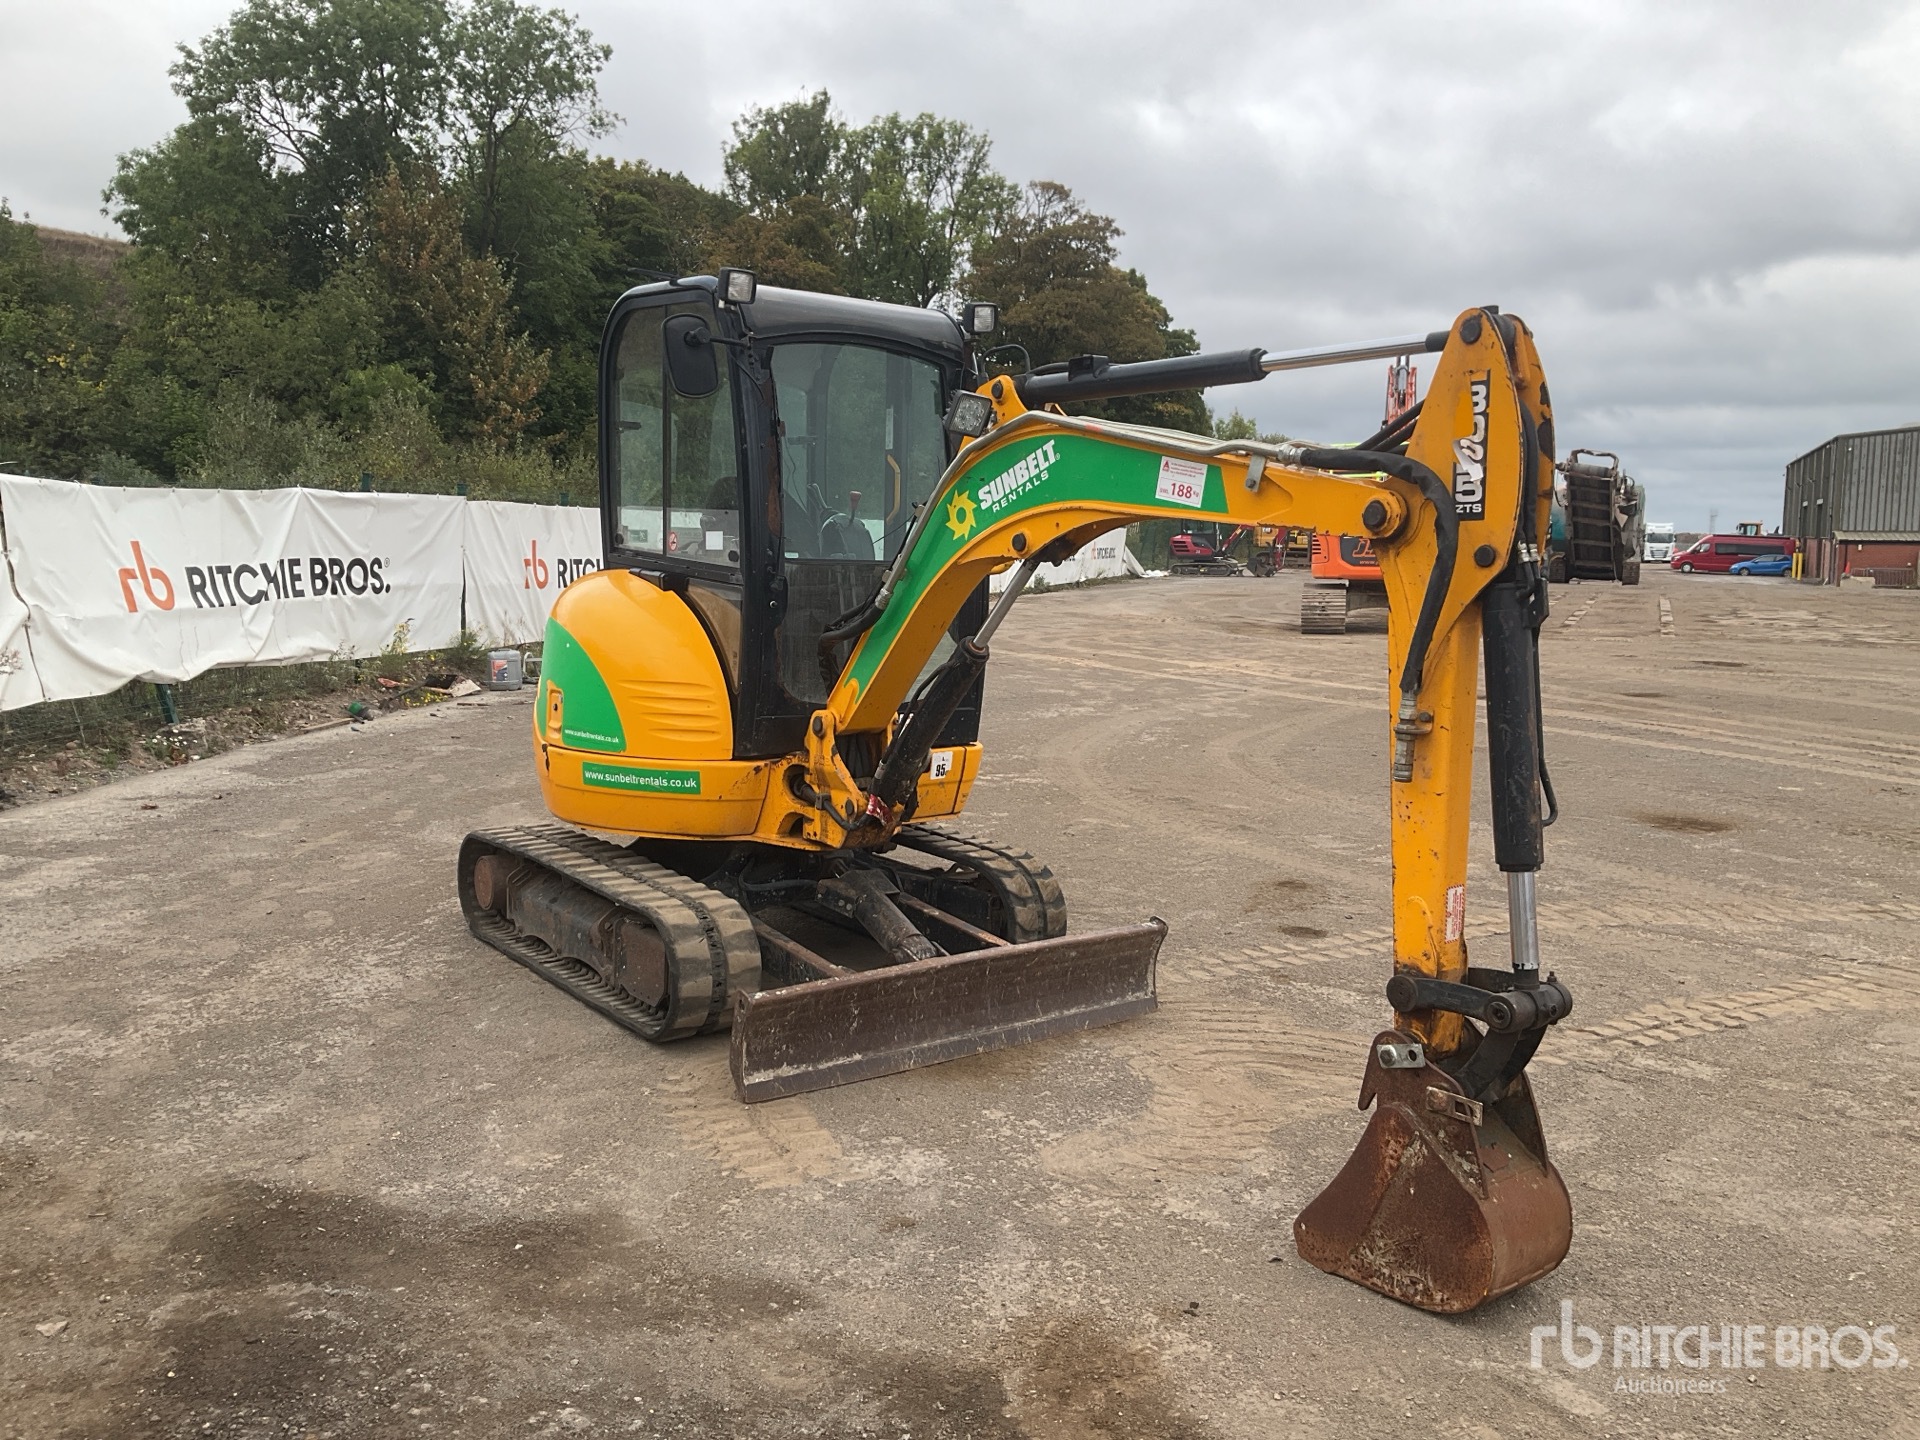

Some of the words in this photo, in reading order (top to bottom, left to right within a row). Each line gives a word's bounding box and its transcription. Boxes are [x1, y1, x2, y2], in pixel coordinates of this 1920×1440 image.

[977, 439, 1057, 511] SUNBELT
[992, 470, 1050, 513] RENTALS
[1171, 482, 1193, 499] 188
[1455, 503, 1483, 514] ZTS
[118, 540, 175, 613] rb
[186, 557, 304, 609] RITCHIE
[310, 556, 391, 597] BROS.
[564, 728, 619, 743] www.sunbeltrentals.co.uk
[584, 769, 698, 789] www.sunbeltrentals.co.uk
